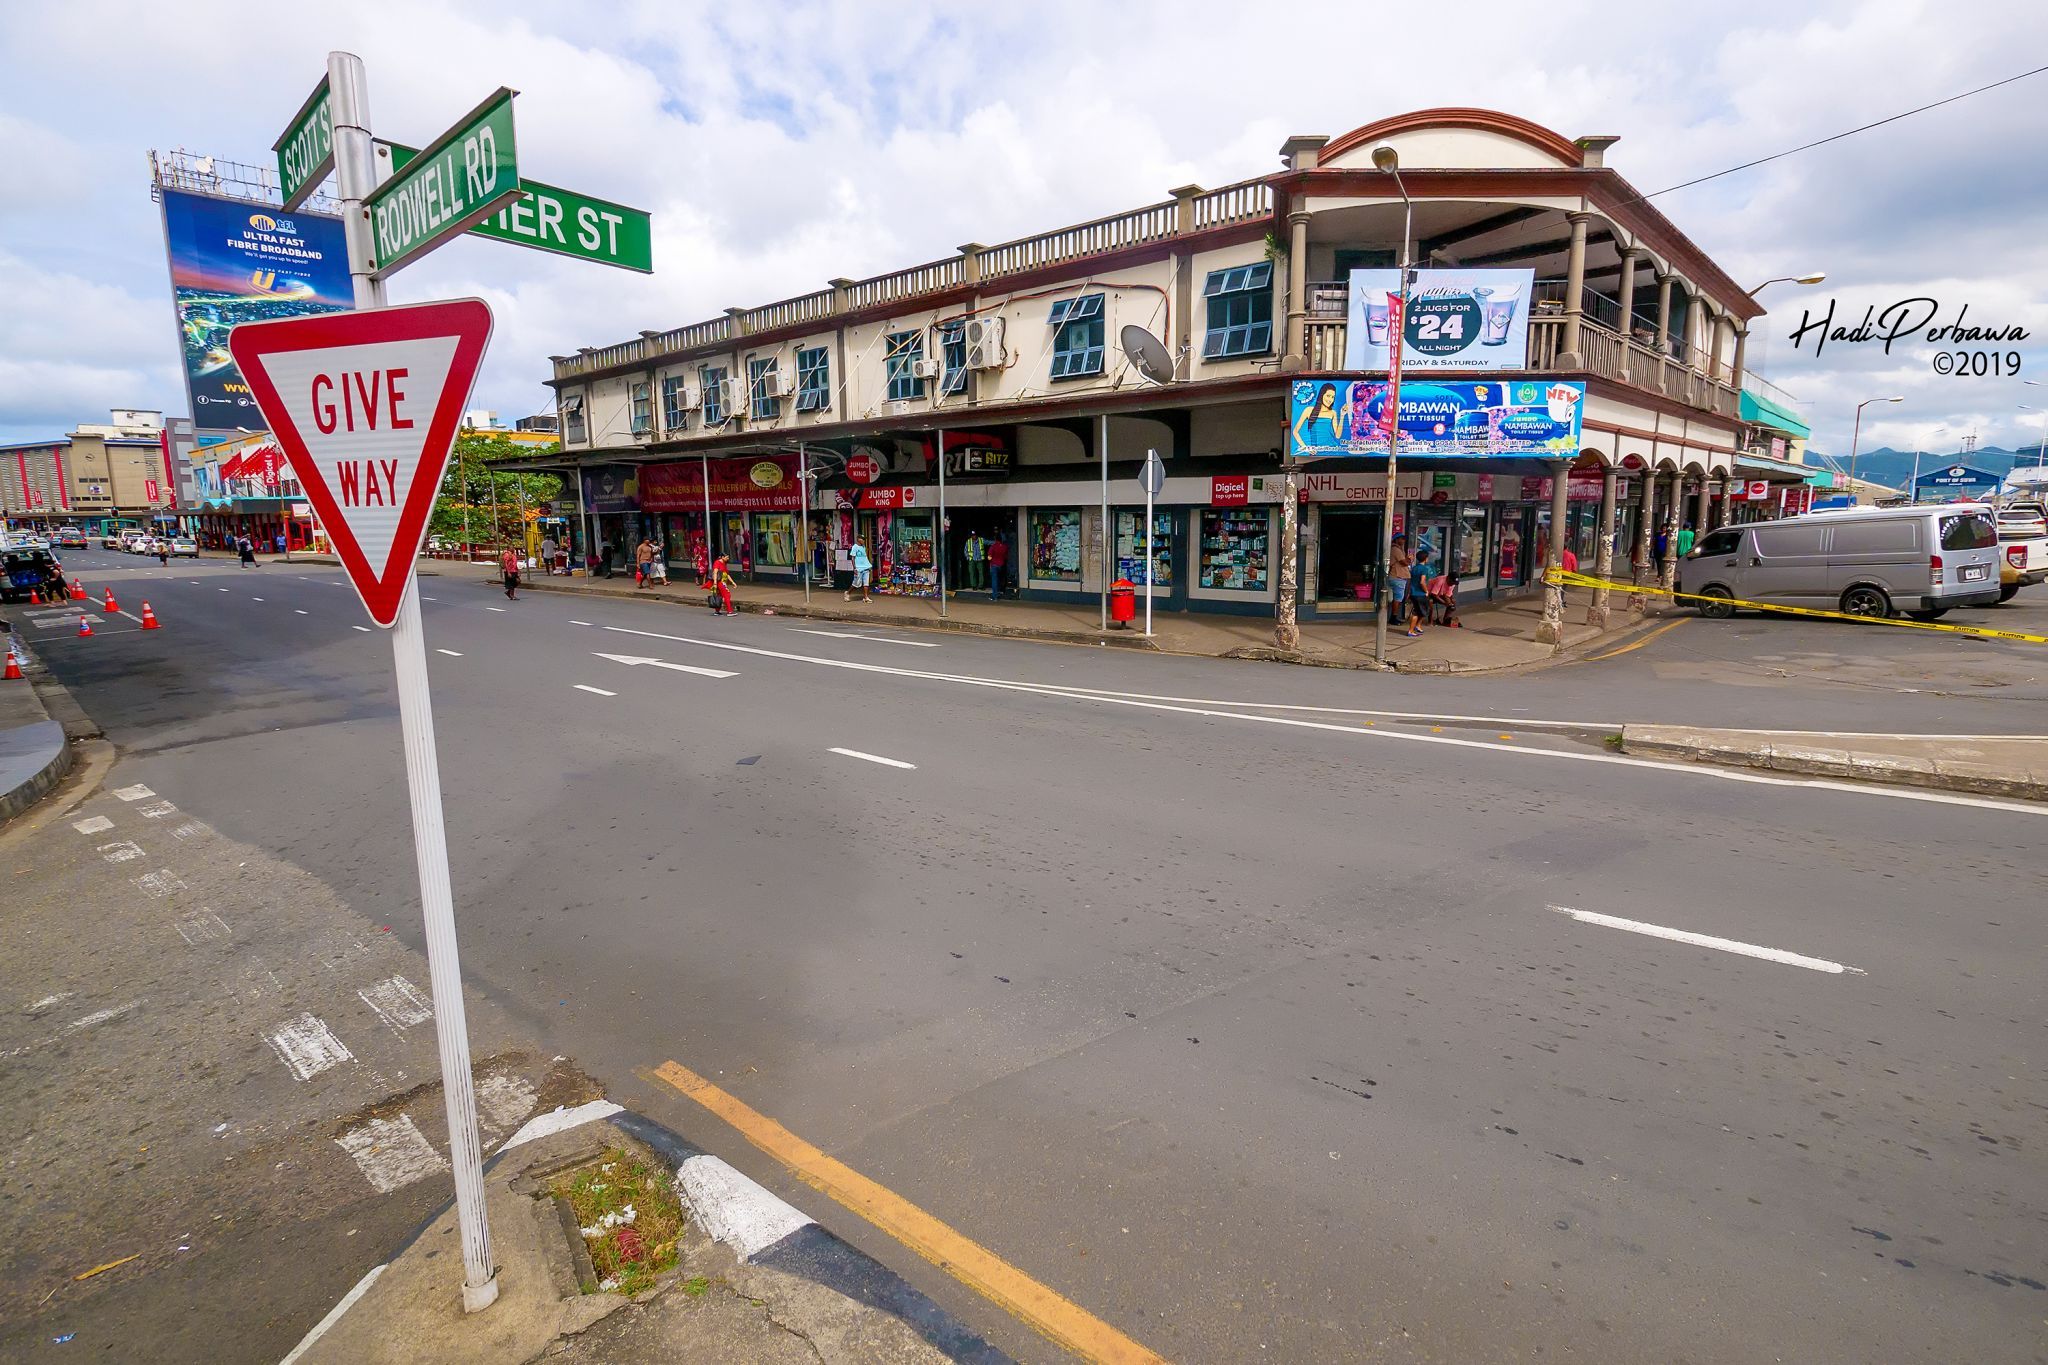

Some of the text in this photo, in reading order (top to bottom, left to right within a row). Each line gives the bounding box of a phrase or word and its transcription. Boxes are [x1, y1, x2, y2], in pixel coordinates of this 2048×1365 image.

[285, 114, 320, 193] SCOTT
[377, 125, 497, 260] RODWELL RD
[243, 231, 305, 247] ULTRA FAST
[577, 207, 622, 255] ST
[227, 239, 322, 259] FIBRE BROADBAND
[1411, 315, 1463, 340] $24
[312, 368, 414, 434] GIVE
[1547, 389, 1579, 404] NEW
[1378, 402, 1460, 413] NMBAWAN
[1505, 422, 1552, 430] NAMBAWAN
[985, 452, 1009, 465] RITZ
[264, 459, 275, 483] Digicel
[337, 459, 398, 507] WAY
[1215, 483, 1244, 493] Digicel
[1307, 475, 1344, 491] NHL
[868, 490, 896, 499] JUMBO
[1396, 487, 1419, 498] LTD
